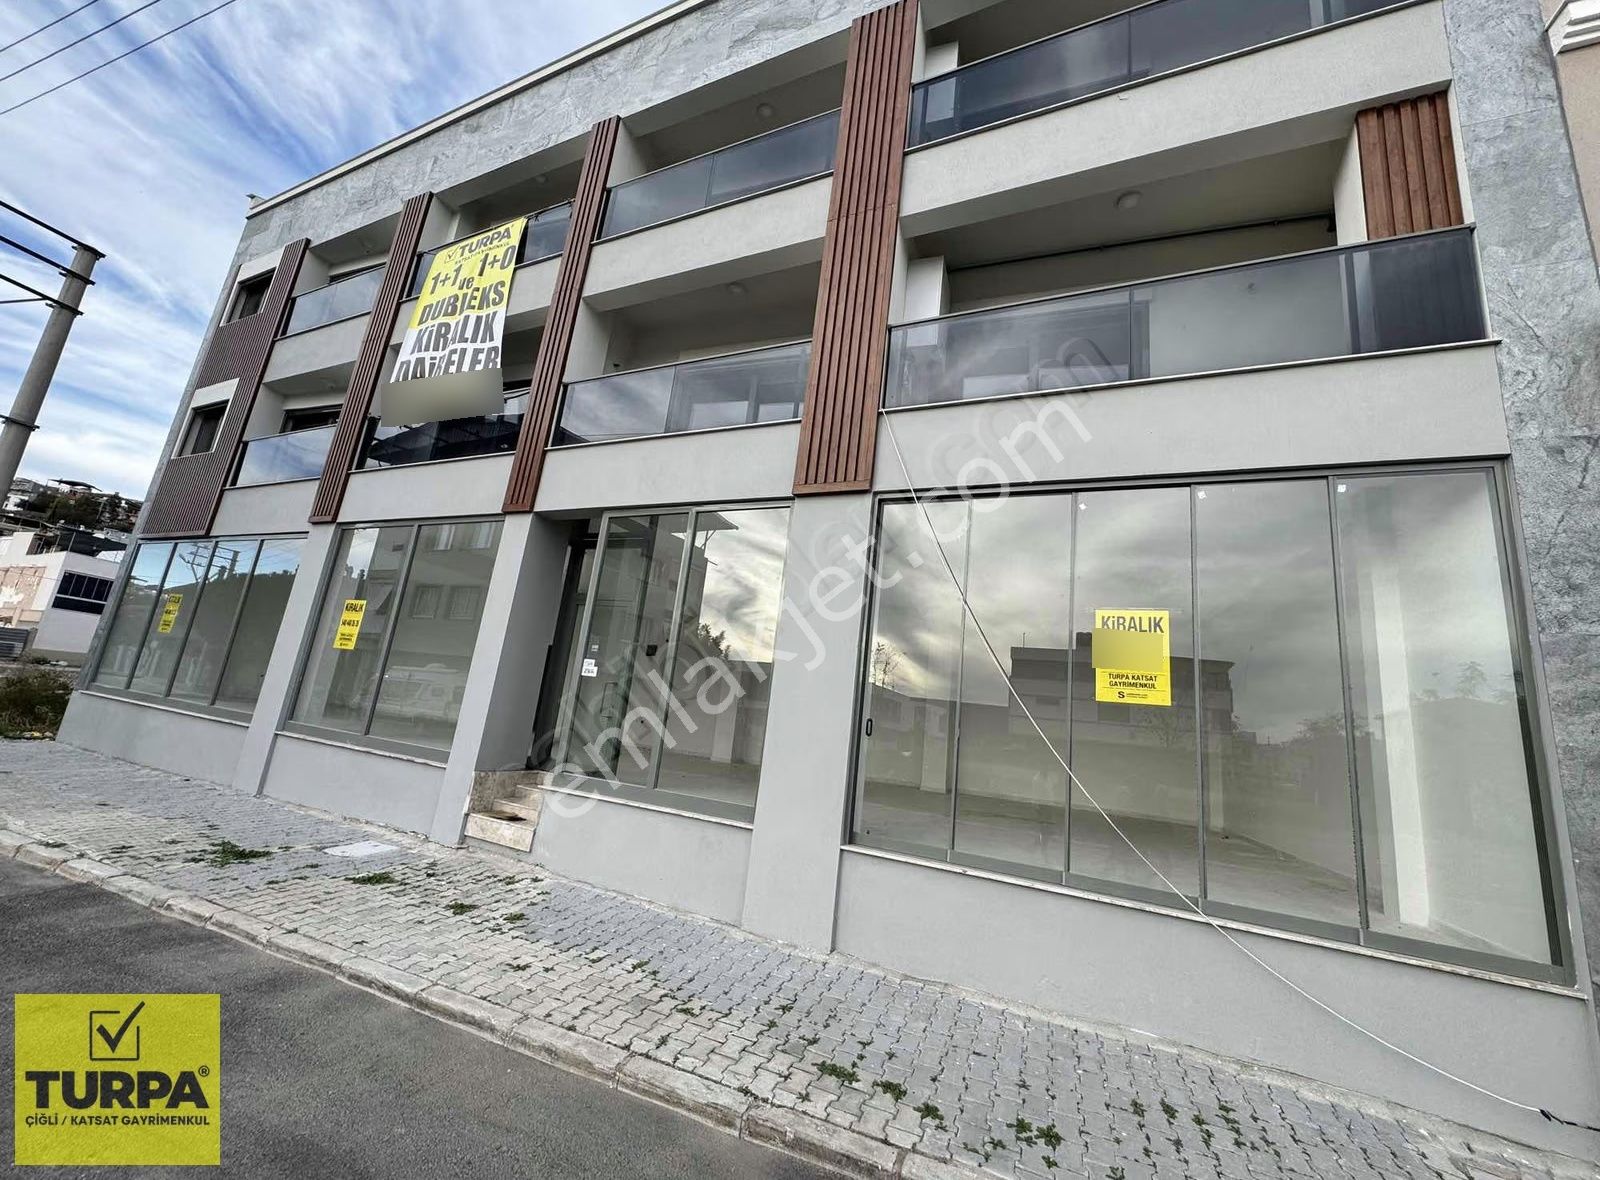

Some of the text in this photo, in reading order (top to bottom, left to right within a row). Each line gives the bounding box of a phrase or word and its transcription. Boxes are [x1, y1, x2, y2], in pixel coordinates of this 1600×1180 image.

[459, 227, 512, 257] TURPA
[430, 264, 462, 295] 1+1
[458, 276, 475, 290] ve
[478, 245, 517, 277] 1+0
[1131, 674, 1157, 682] KATSAT
